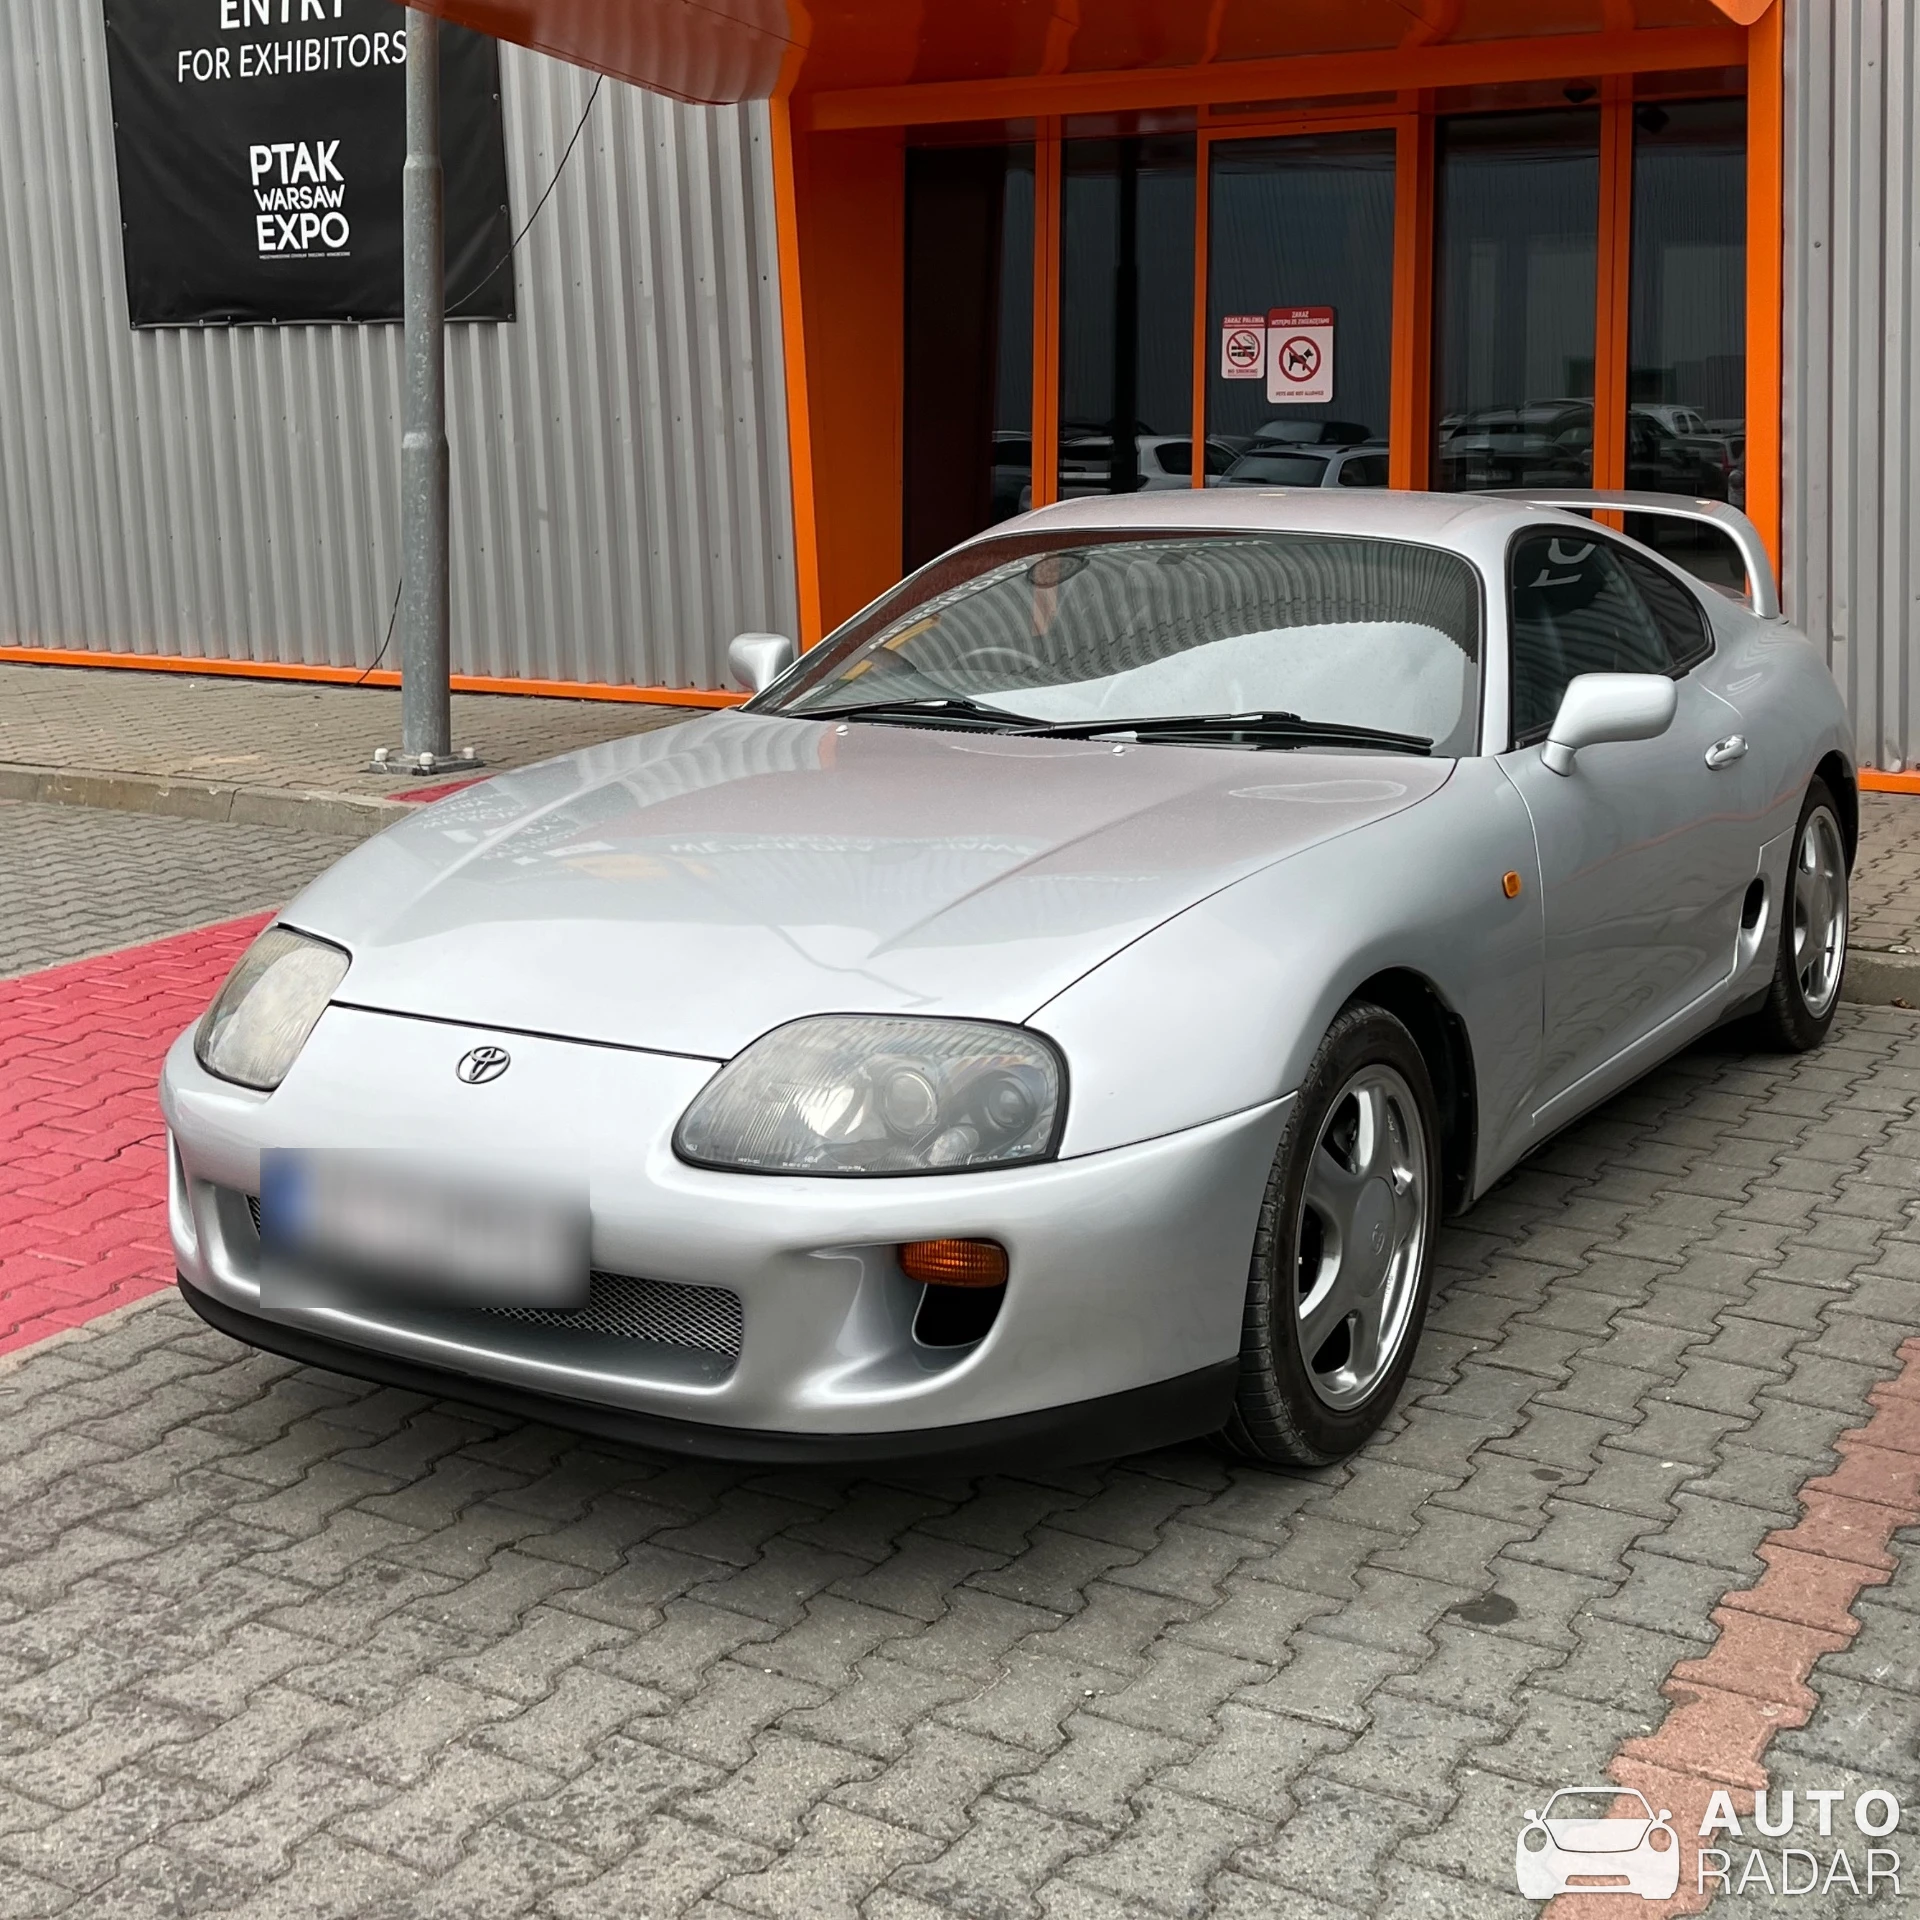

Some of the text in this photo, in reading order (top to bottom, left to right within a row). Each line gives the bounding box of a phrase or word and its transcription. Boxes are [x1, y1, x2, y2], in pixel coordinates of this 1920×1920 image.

[178, 30, 407, 83] FOR EXHIBITORS
[250, 140, 344, 186] PTAK
[253, 184, 345, 211] WARSAW
[256, 212, 350, 251] EXPO
